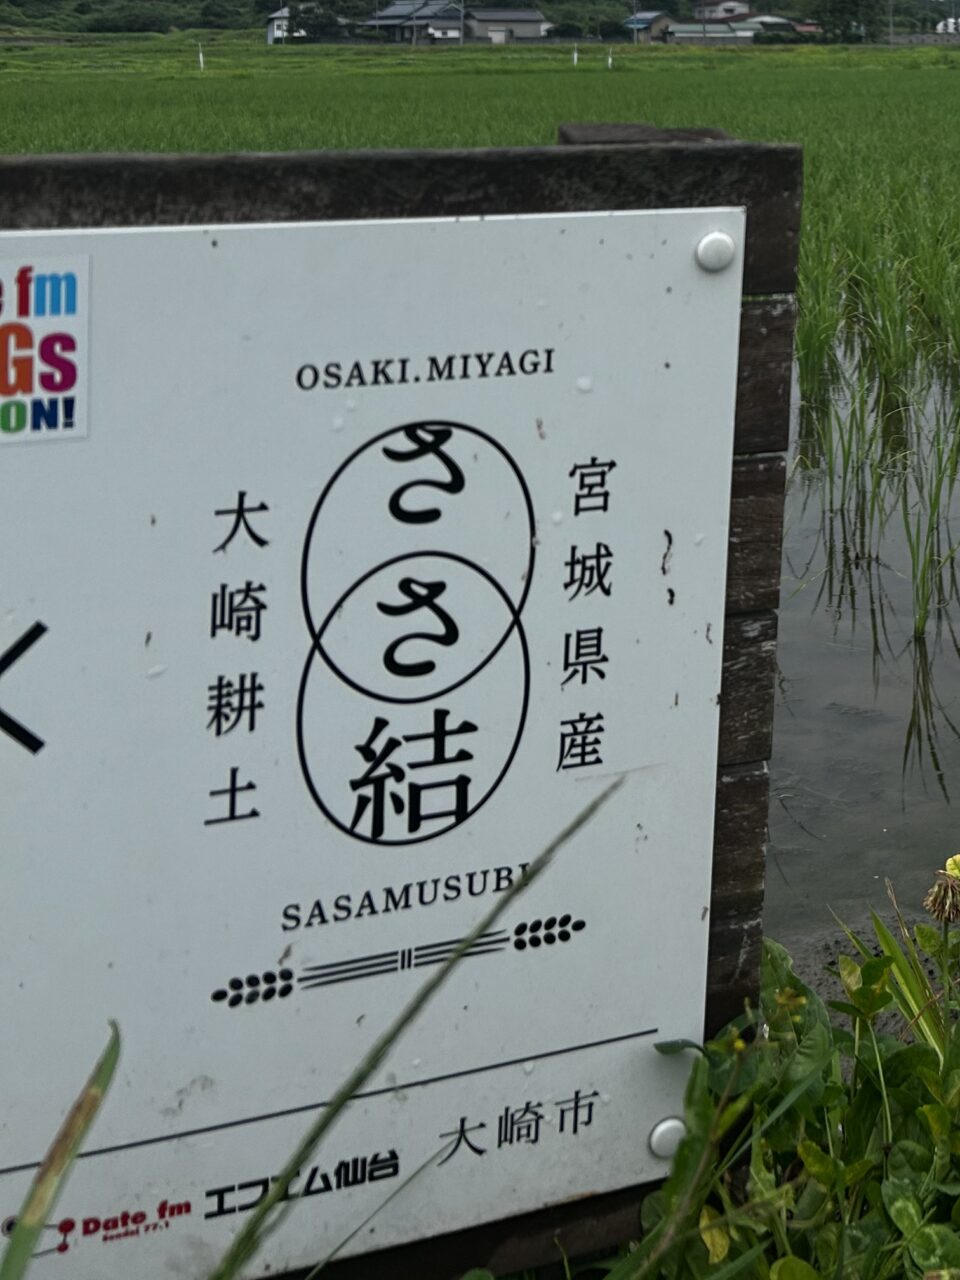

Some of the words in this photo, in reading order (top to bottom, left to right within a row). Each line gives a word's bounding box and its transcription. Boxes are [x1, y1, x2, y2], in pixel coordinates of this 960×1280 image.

[15, 265, 77, 318] fm
[296, 348, 555, 390] OSAKI.MIYAGI
[556, 456, 617, 773] 宮城県産
[203, 489, 270, 827] 大崎耕土
[437, 1089, 599, 1167] 大崎市
[82, 1210, 147, 1236] Date
[157, 1199, 192, 1220] fm
